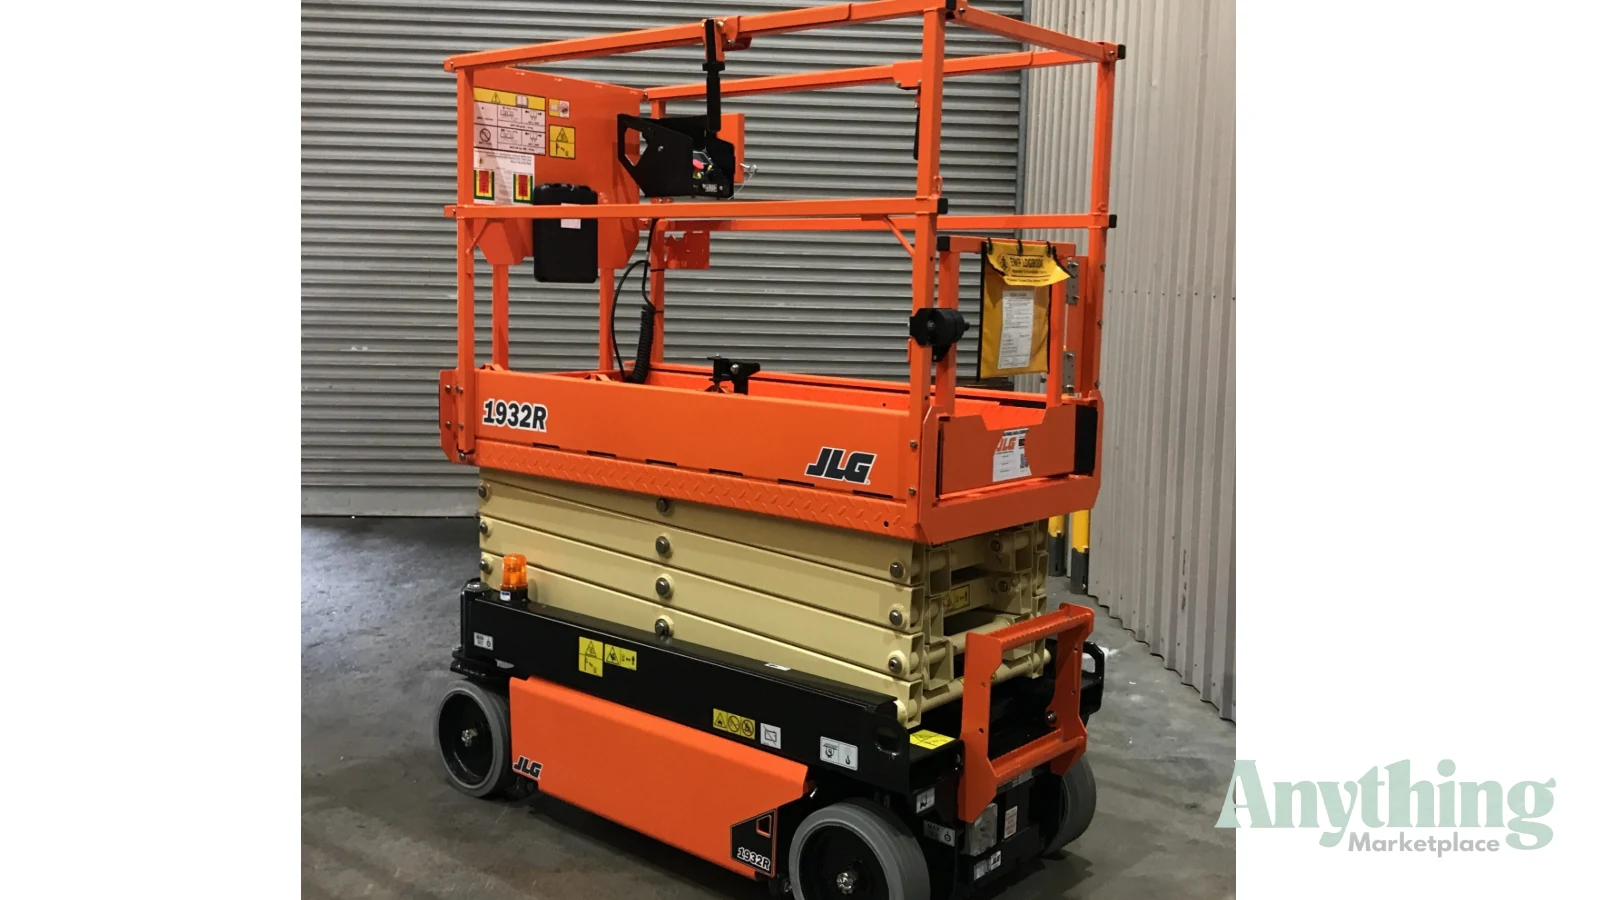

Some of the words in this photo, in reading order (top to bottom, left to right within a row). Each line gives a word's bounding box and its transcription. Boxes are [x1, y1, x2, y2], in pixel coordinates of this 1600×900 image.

[483, 399, 547, 431] 1932R
[804, 447, 876, 484] JLG
[513, 756, 542, 778] JLG
[737, 847, 771, 871] 1932R
